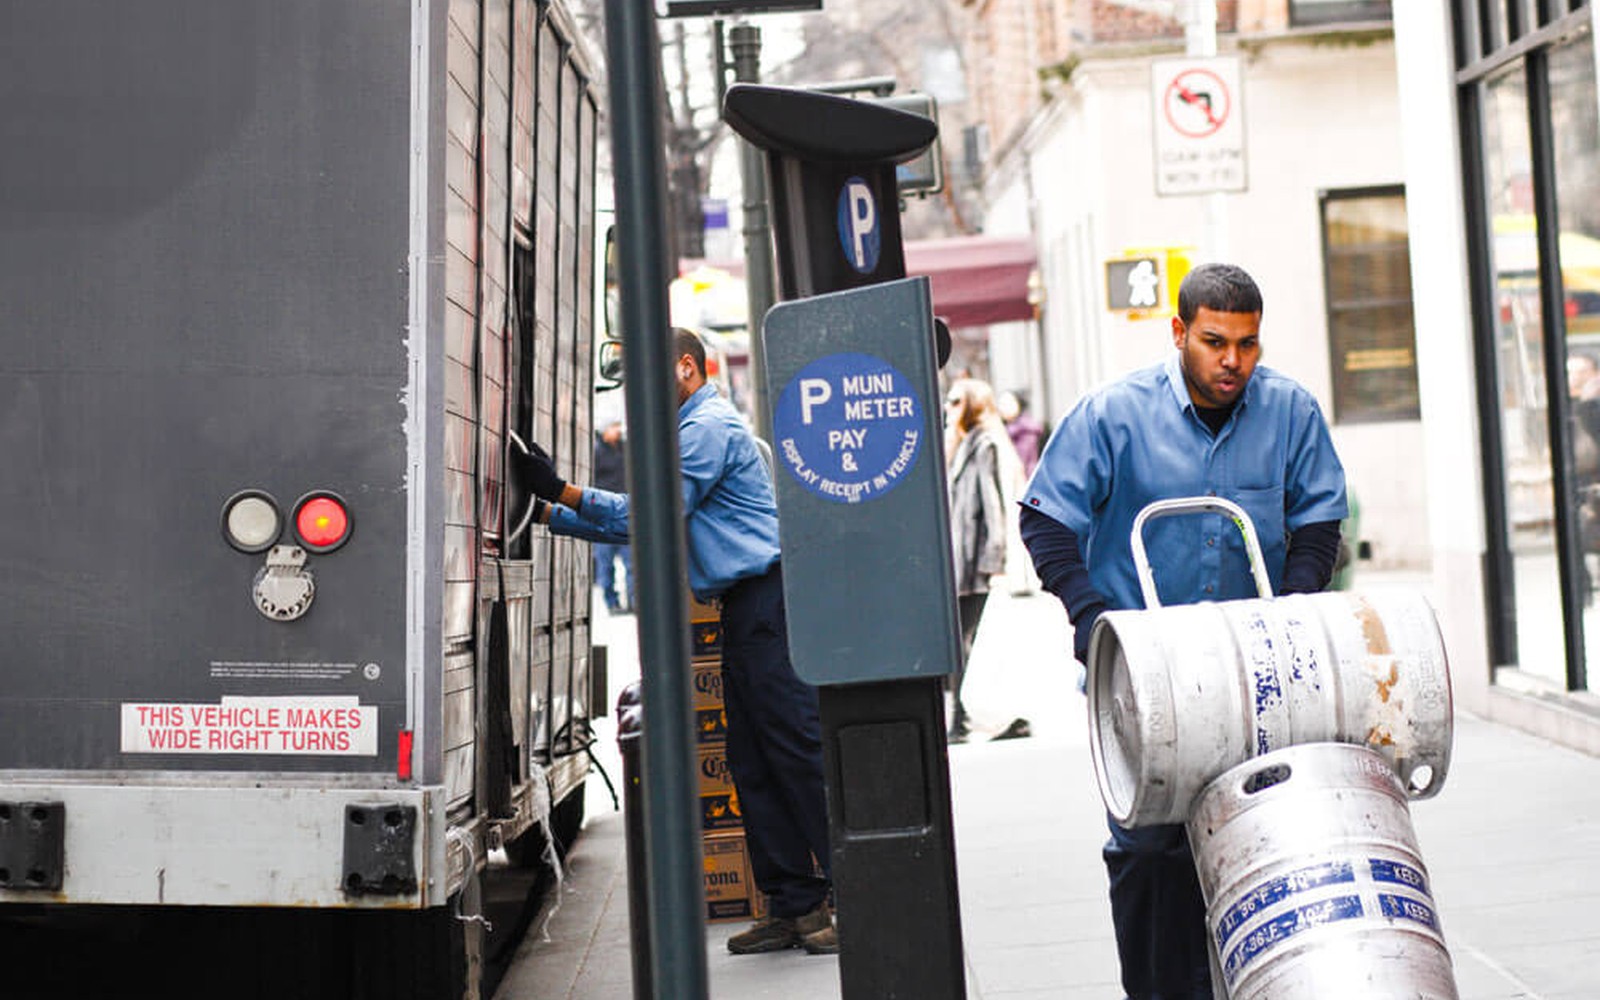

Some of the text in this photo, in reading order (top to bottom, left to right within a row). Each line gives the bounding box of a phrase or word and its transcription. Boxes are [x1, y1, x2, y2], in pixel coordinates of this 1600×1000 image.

[849, 183, 875, 267] P
[842, 373, 893, 396] MUNI
[800, 378, 832, 425] P
[844, 397, 914, 421] METER
[828, 428, 867, 451] PAY
[781, 429, 919, 497] DISPLAY RECEIPT IN VEHICLE
[842, 452, 858, 472] &
[136, 706, 362, 729] THIS VEHICLE MAKES
[148, 729, 351, 751] WIDE RIGHT TURNS
[1393, 864, 1421, 887] KEEP
[1402, 901, 1430, 920] KEEP
